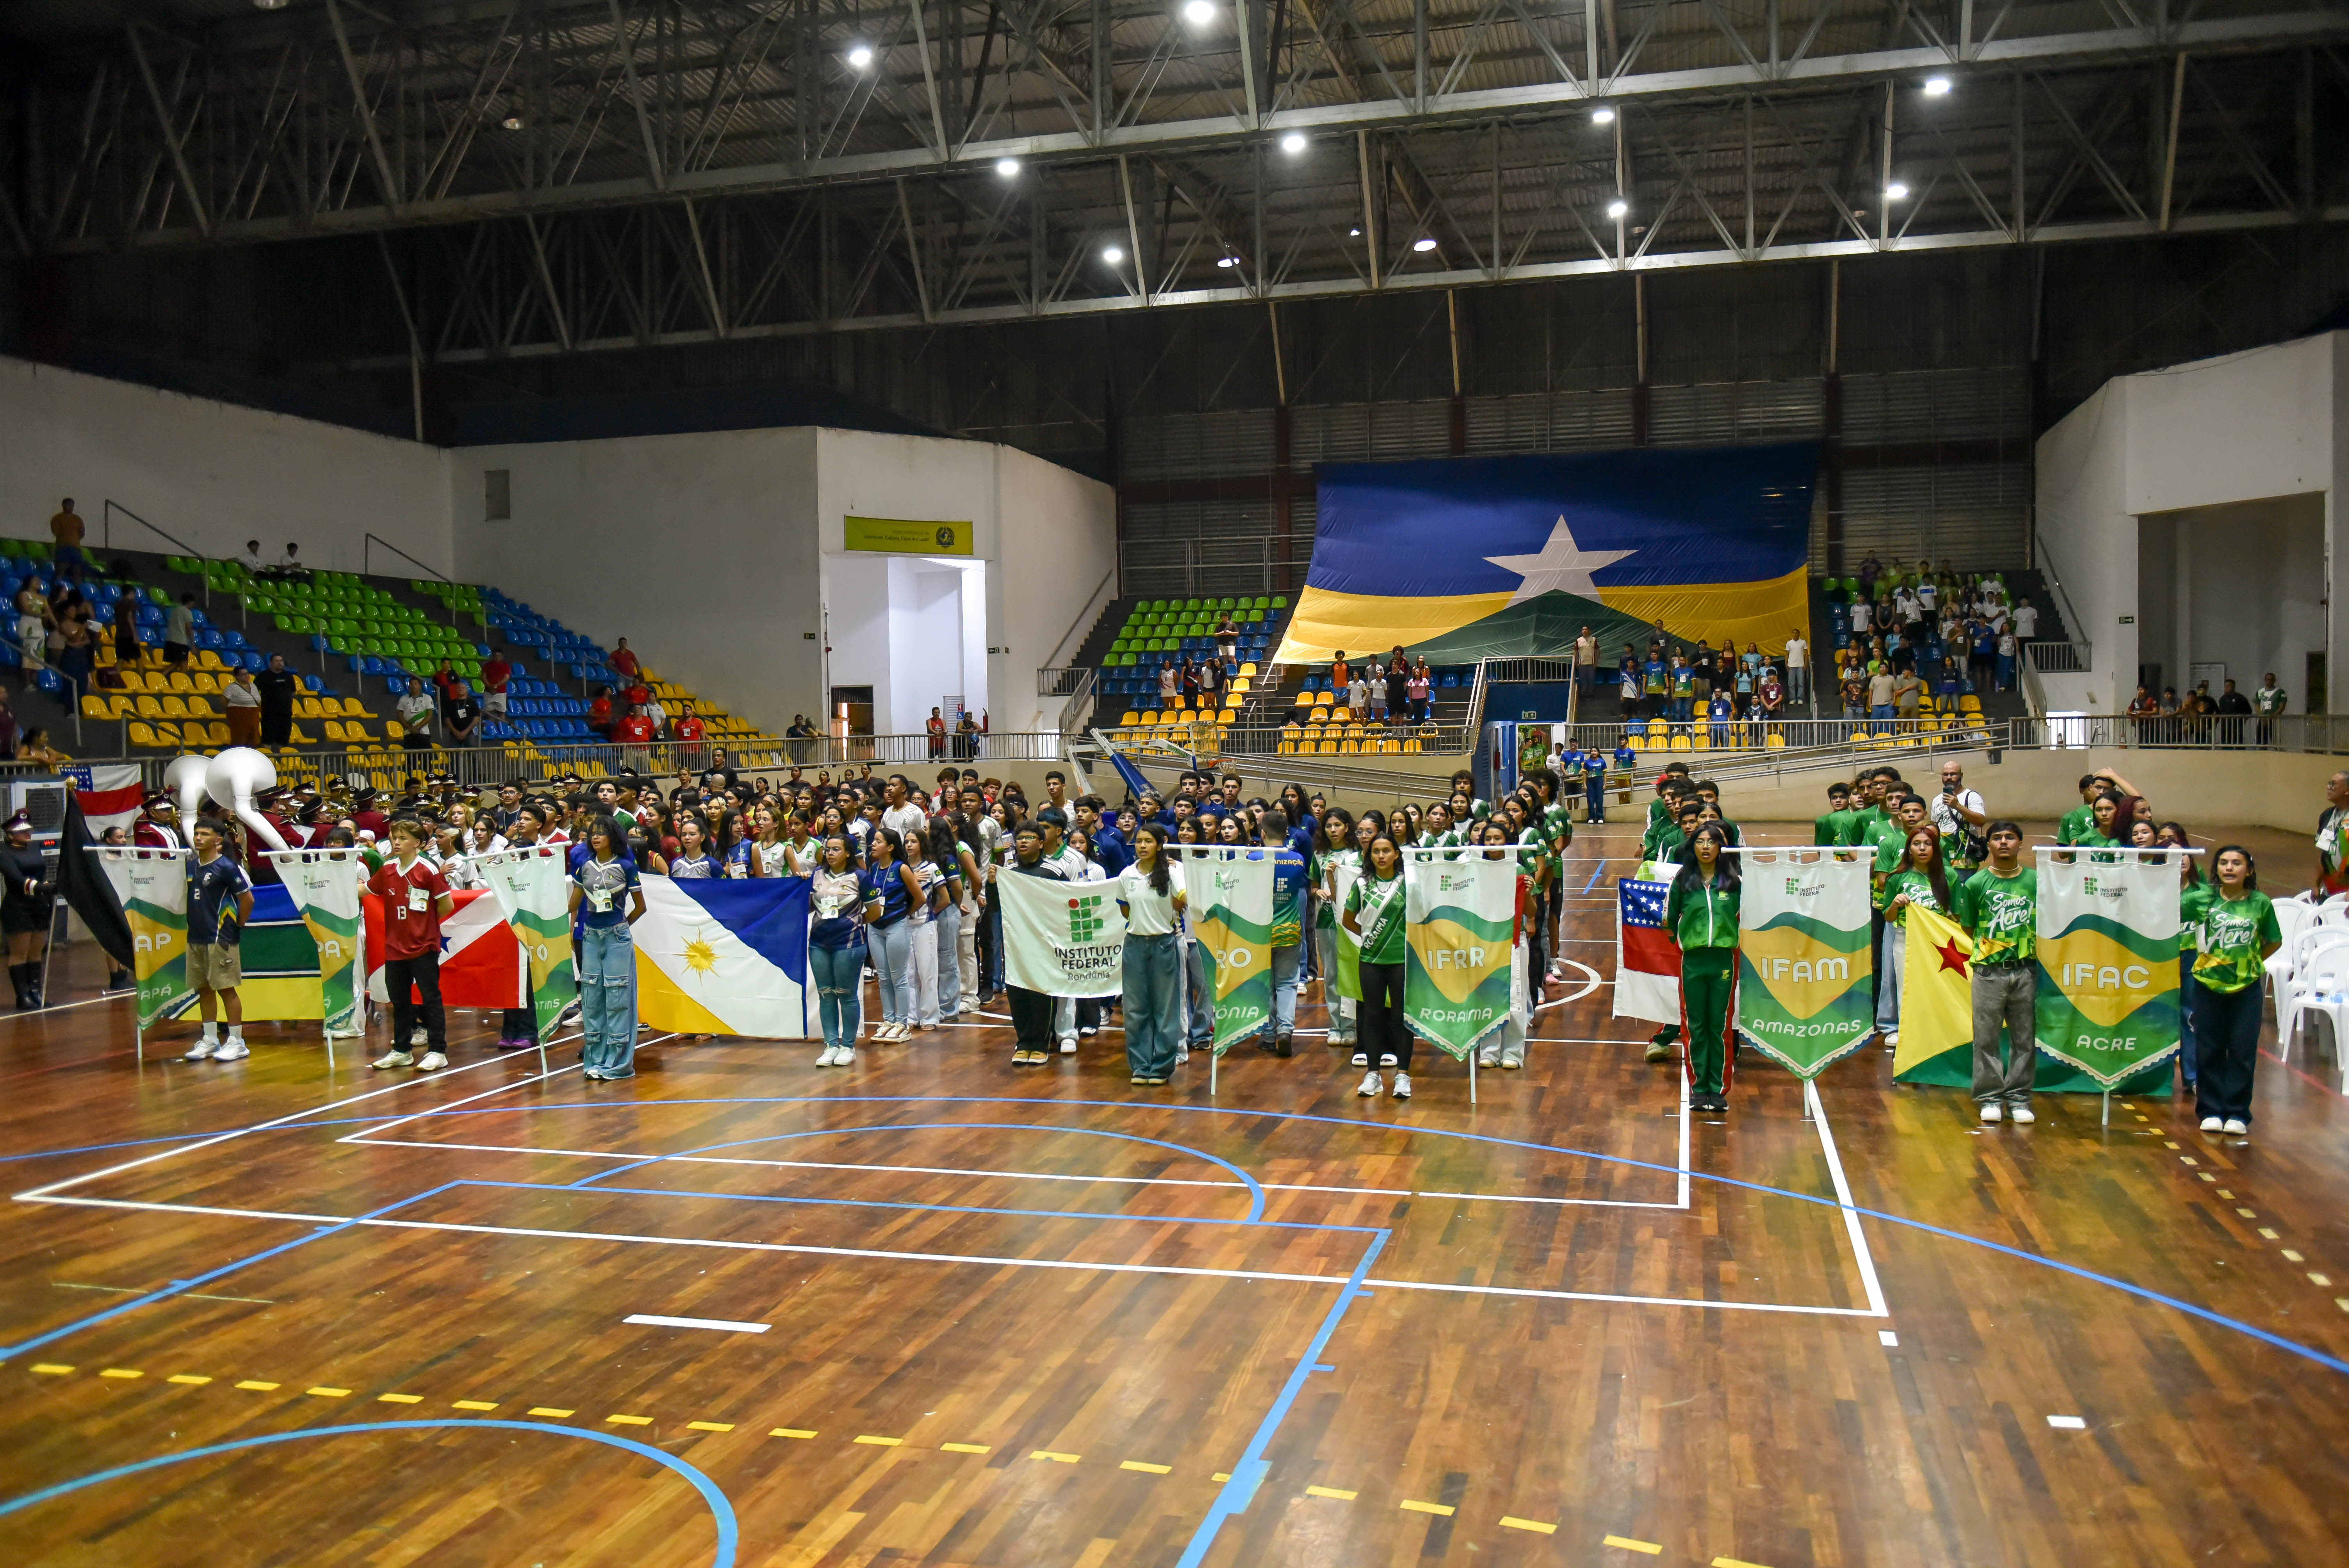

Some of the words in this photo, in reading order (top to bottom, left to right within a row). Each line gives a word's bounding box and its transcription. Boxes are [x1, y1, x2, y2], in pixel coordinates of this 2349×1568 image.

[194, 888, 200, 900] 2
[1992, 894, 2026, 911] Somos
[397, 906, 406, 919] 13
[1987, 901, 2034, 939] Acre!
[2212, 914, 2251, 928] Somos
[1363, 918, 1388, 950] RORAIMA
[2205, 925, 2257, 954] Acre!
[1054, 944, 1122, 959] INSTITUTO
[1428, 946, 1485, 970] IFRR
[1062, 957, 1116, 969] FEDERAL
[1761, 957, 1848, 983] IFAM
[1068, 971, 1110, 981] Rondônia
[2063, 963, 2149, 989] IFAC
[1420, 1007, 1492, 1023] RORAIMA
[1752, 1019, 1861, 1037] AMAZONAS
[2076, 1035, 2137, 1051] ACRE
